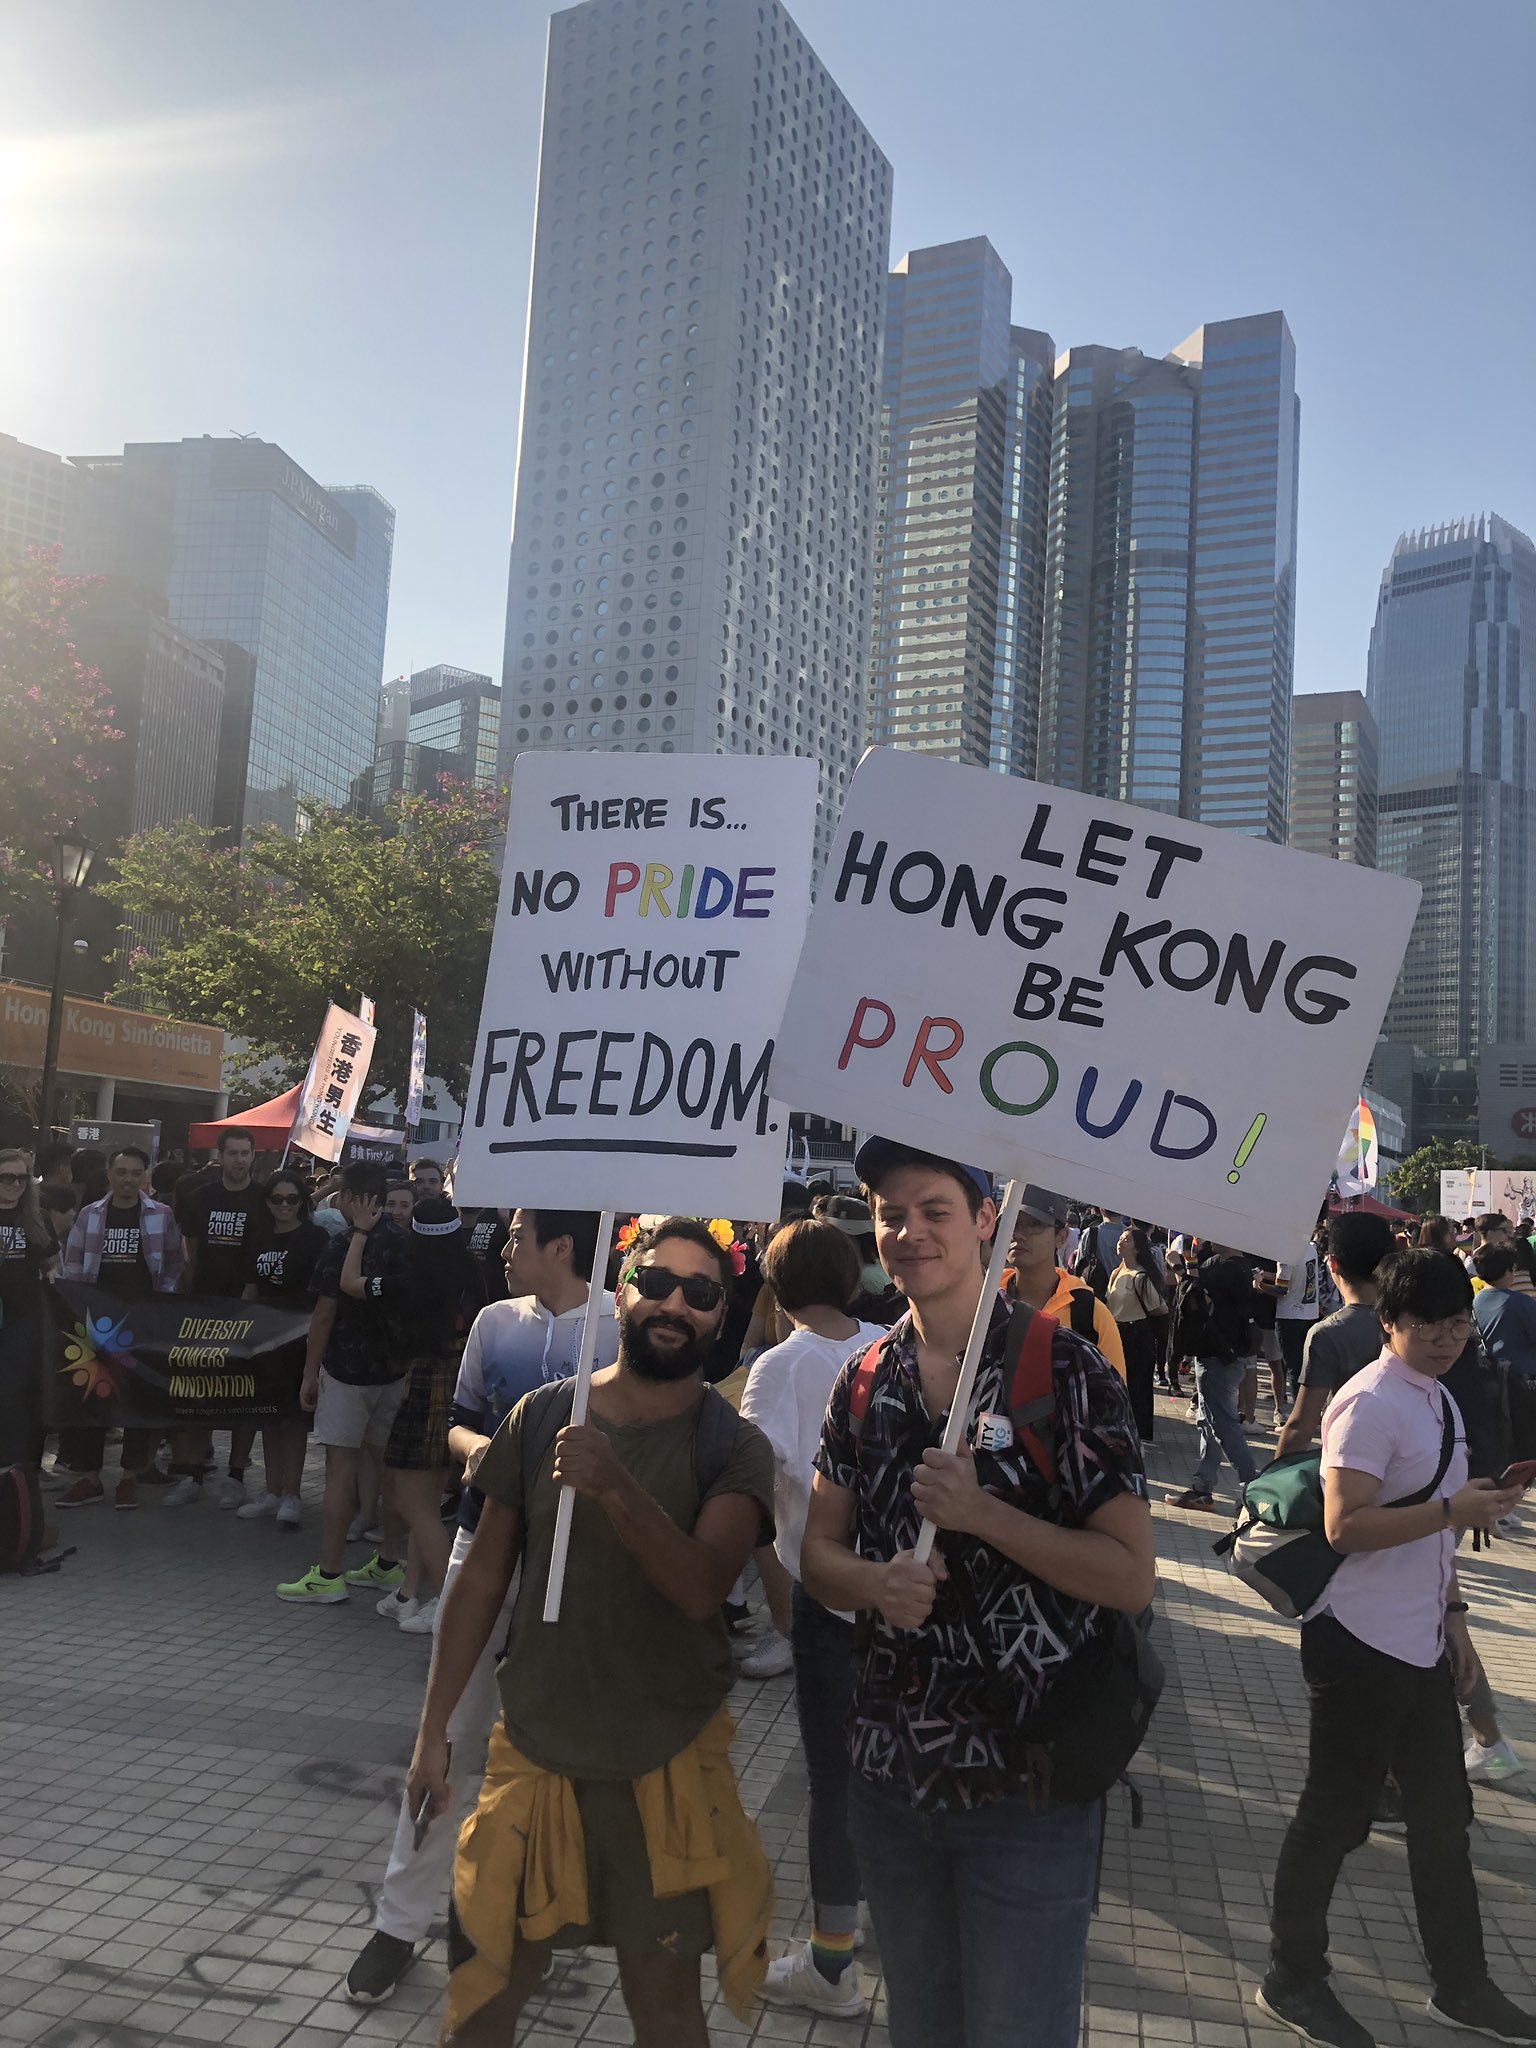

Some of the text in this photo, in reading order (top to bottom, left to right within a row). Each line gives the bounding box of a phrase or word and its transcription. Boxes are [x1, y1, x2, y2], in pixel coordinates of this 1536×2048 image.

[551, 794, 747, 831] THERE IS...
[1021, 804, 1202, 899] LET
[511, 862, 776, 918] NO PRIDE
[834, 831, 1357, 1024] HONG KONG
[1013, 962, 1105, 1026] BE
[5, 996, 212, 1057] Hon Kong Sinfonietta
[315, 1032, 363, 1137] 香港男生
[475, 1028, 778, 1135] FREEDOM.
[77, 1127, 100, 1140] 香港
[366, 1147, 383, 1161] First
[208, 1221, 233, 1236] 2019
[210, 1211, 237, 1222] PRIDE
[233, 1212, 247, 1237] CAPCO
[102, 1239, 128, 1253] 2019
[482, 1223, 497, 1250] CAPCO
[178, 1317, 254, 1340] DIVERSITY
[168, 1345, 230, 1368] POWERS
[169, 1375, 256, 1399] INNOVATION
